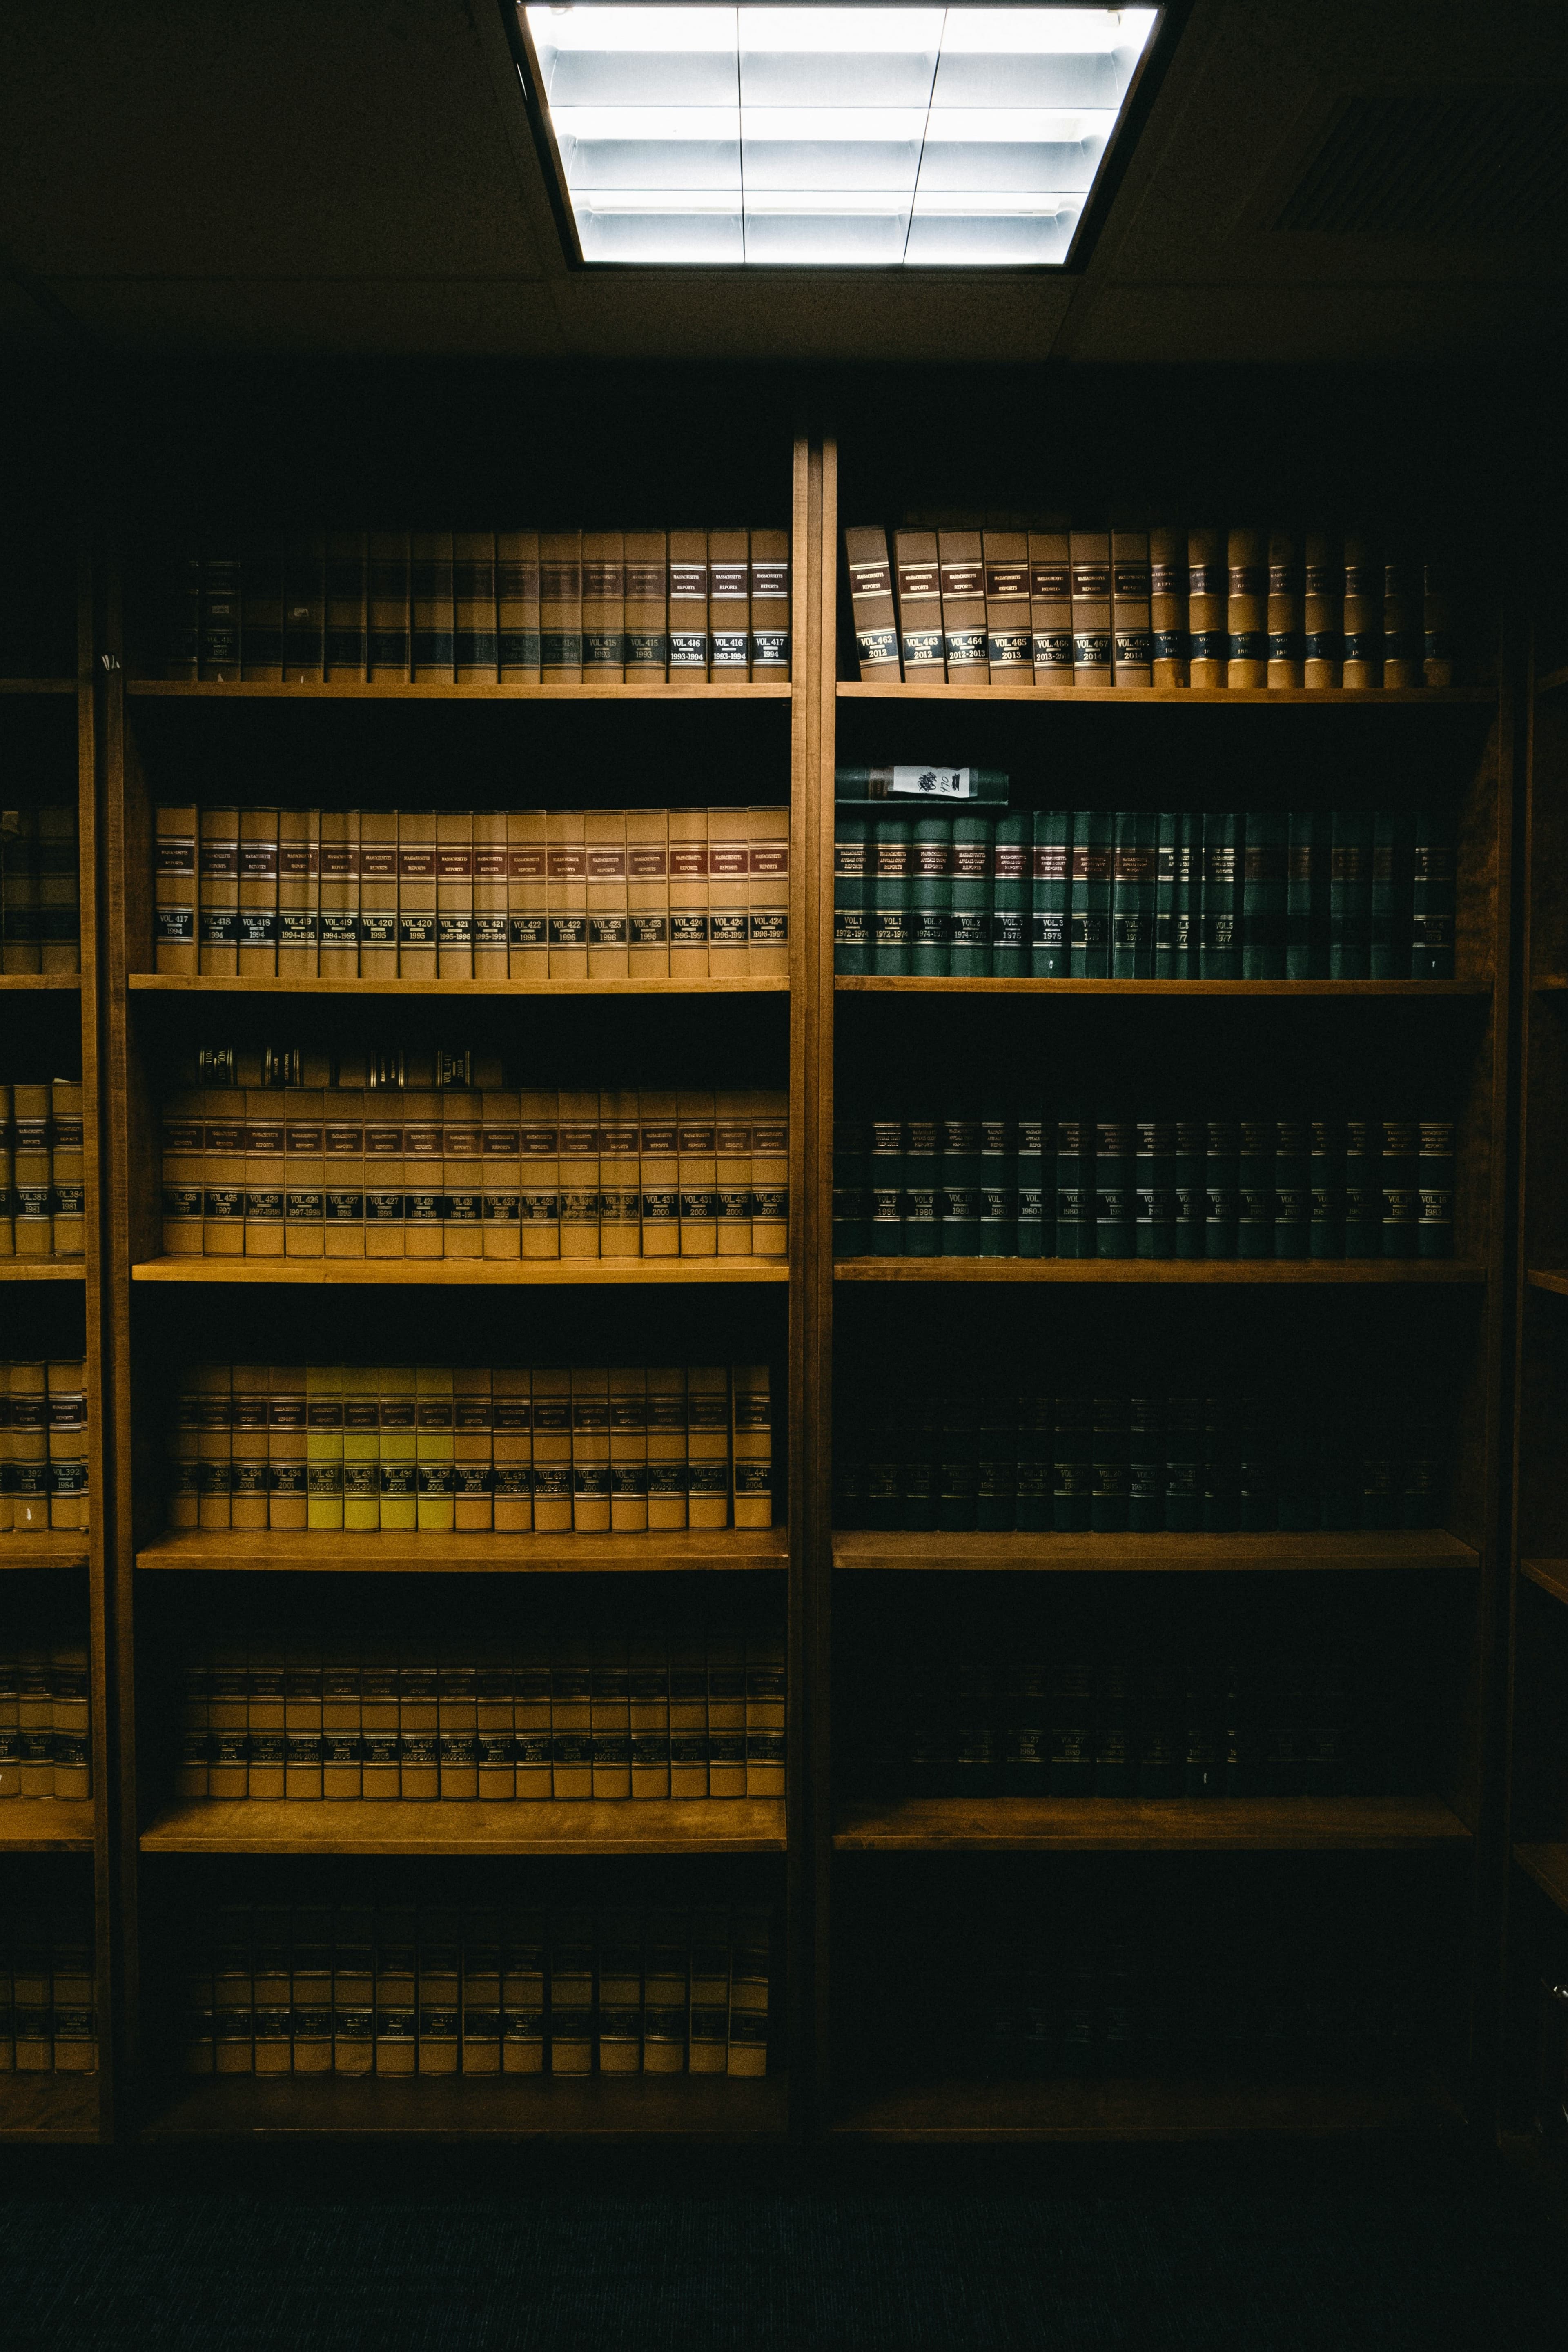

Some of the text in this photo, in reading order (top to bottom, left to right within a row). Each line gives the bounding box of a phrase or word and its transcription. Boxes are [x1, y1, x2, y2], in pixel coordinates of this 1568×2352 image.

[861, 635, 892, 646] VOL. 462
[907, 637, 938, 647] VOL. 463
[995, 639, 1011, 647] VOL.
[1037, 640, 1054, 648] VOL.
[1077, 640, 1093, 648] VOL.
[1117, 639, 1134, 647] VOL.
[869, 649, 887, 658] 2012
[914, 650, 932, 659] 2012
[949, 650, 985, 659] 2012-2013
[940, 777, 950, 793] 470
